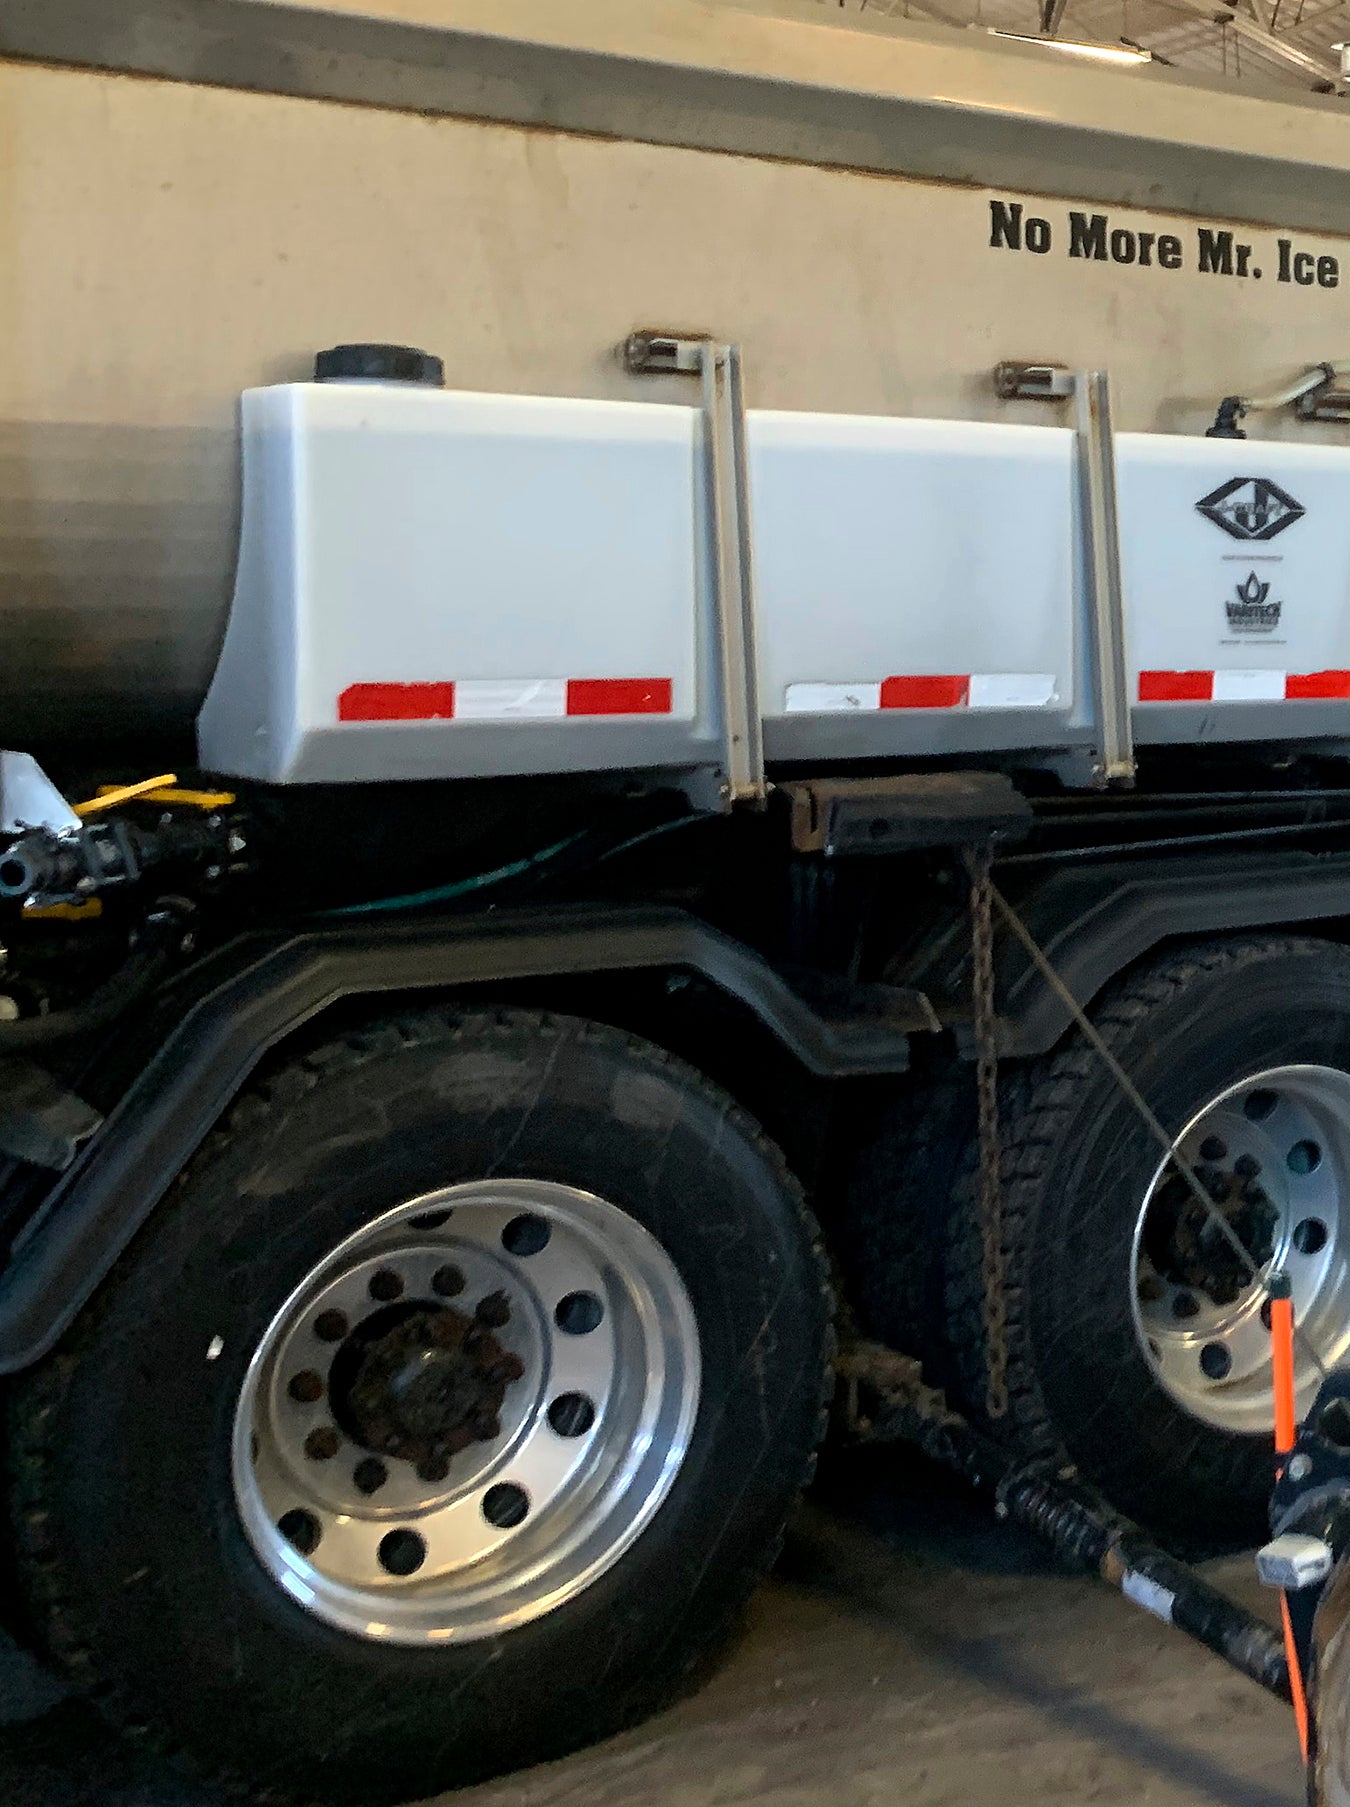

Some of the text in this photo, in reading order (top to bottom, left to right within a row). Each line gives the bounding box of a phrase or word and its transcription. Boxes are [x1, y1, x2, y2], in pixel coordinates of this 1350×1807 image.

[989, 200, 1052, 255] No
[1068, 211, 1183, 270] More
[1198, 227, 1262, 280] Mr.
[1277, 238, 1339, 289] Ice
